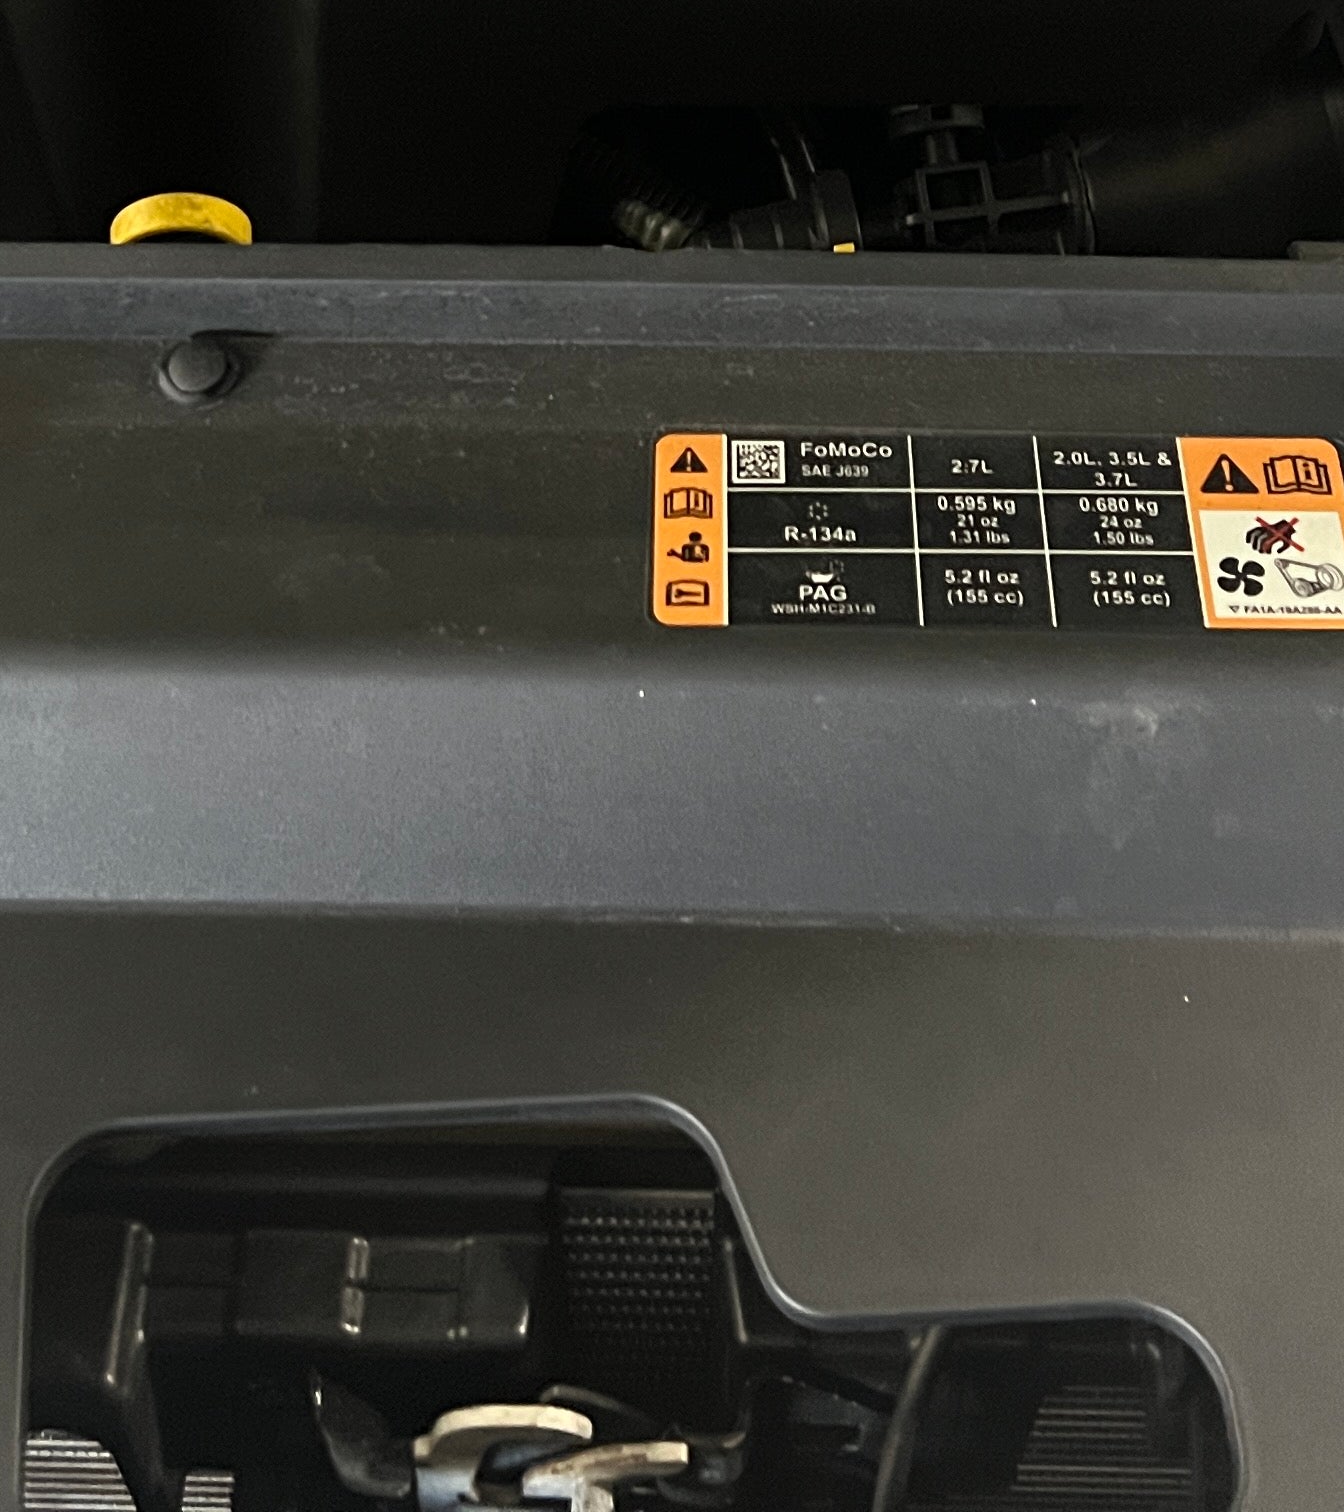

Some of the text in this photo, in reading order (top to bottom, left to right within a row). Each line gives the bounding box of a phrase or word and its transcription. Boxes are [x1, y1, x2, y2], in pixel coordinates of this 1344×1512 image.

[800, 441, 893, 458] FoMoCo
[950, 458, 995, 475] 2.7L
[1108, 450, 1152, 467] 3.5L
[1157, 451, 1172, 467] &
[801, 464, 831, 477] SAE
[1094, 471, 1138, 488] 3.7L
[937, 495, 1016, 515] 0.595 kg
[1078, 496, 1159, 517] 0.680 kg
[957, 513, 1000, 528] 21 oz
[1099, 515, 1143, 529] 24 oz
[784, 525, 857, 542] R-134a
[950, 530, 1010, 544] 1.31 lbs
[1093, 530, 1154, 546] 1.50 lbs
[944, 569, 973, 585] 5.2
[996, 571, 1020, 585] oz
[1089, 570, 1118, 586] 5.2
[1142, 573, 1166, 586] oz
[799, 584, 848, 602] PAG
[946, 589, 1024, 607] (155 cc)
[1093, 590, 1171, 608] (155 cc)
